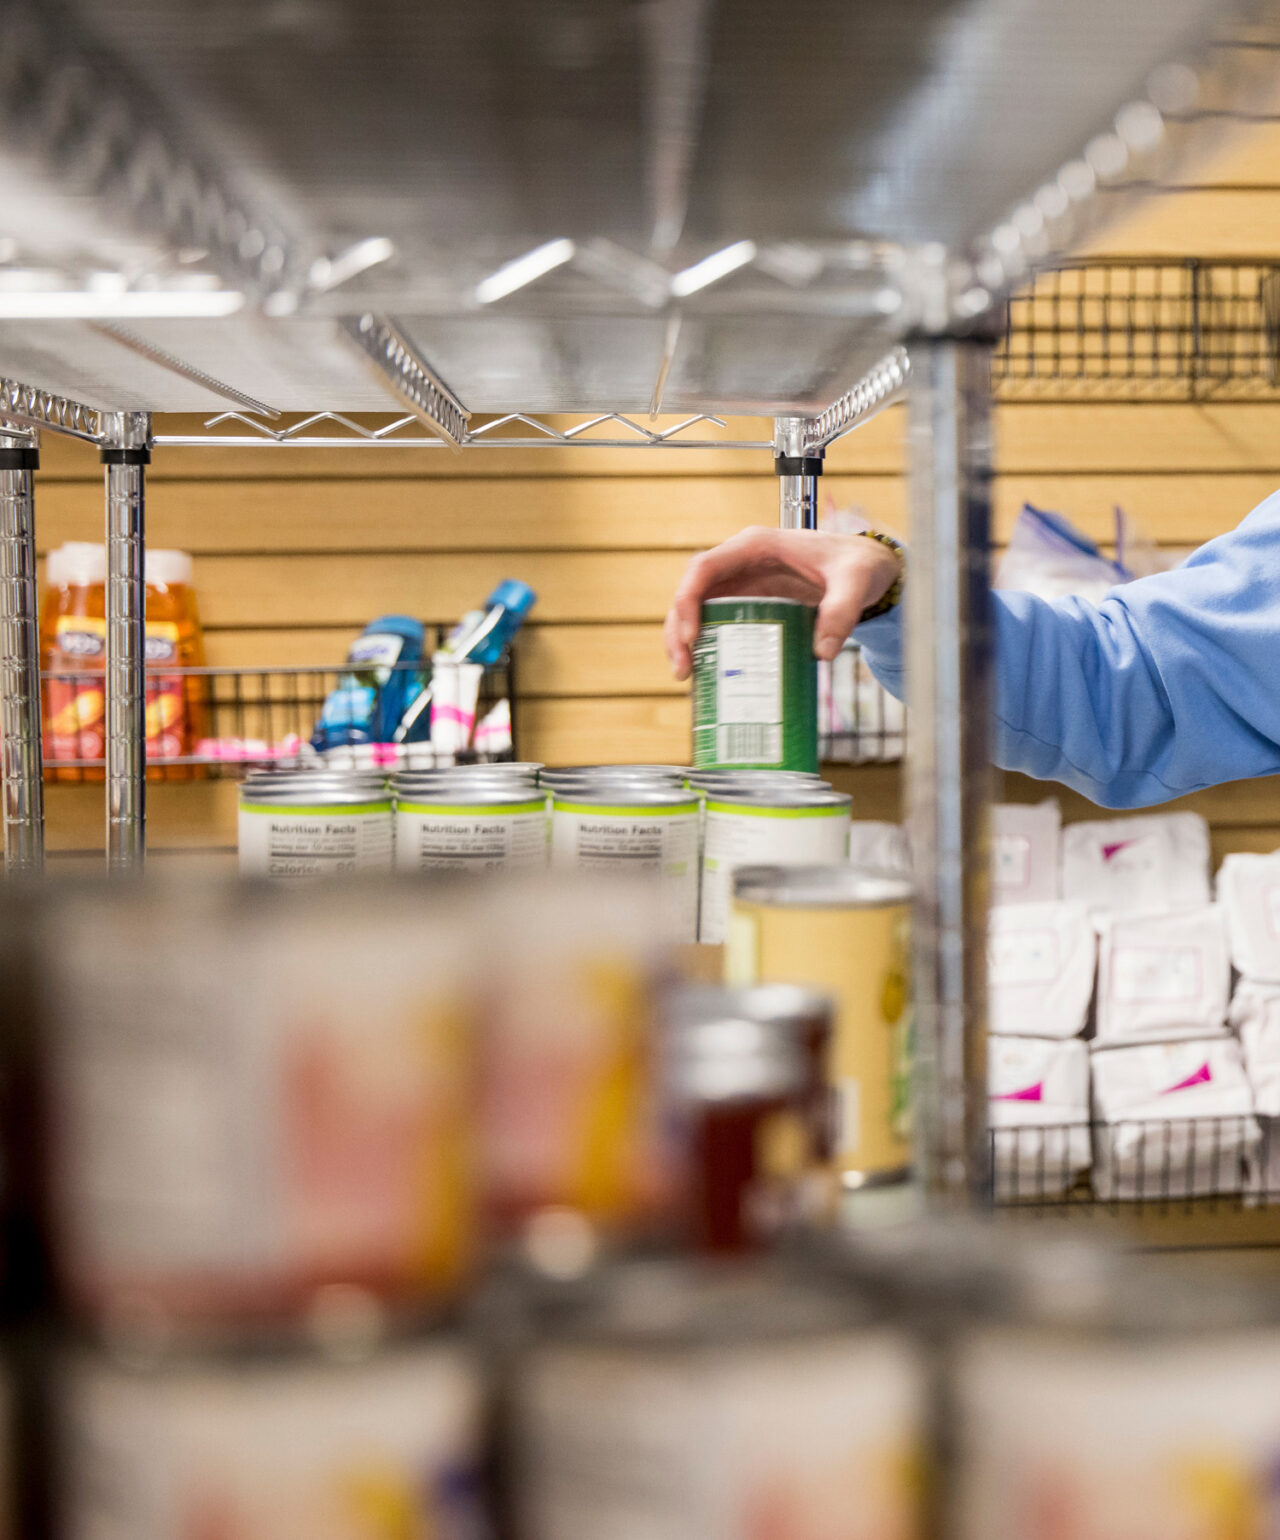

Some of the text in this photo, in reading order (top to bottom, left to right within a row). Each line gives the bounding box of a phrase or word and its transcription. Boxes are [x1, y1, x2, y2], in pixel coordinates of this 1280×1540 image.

[325, 824, 357, 836] Facts
[474, 824, 506, 836] Facts
[631, 824, 664, 836] Facts
